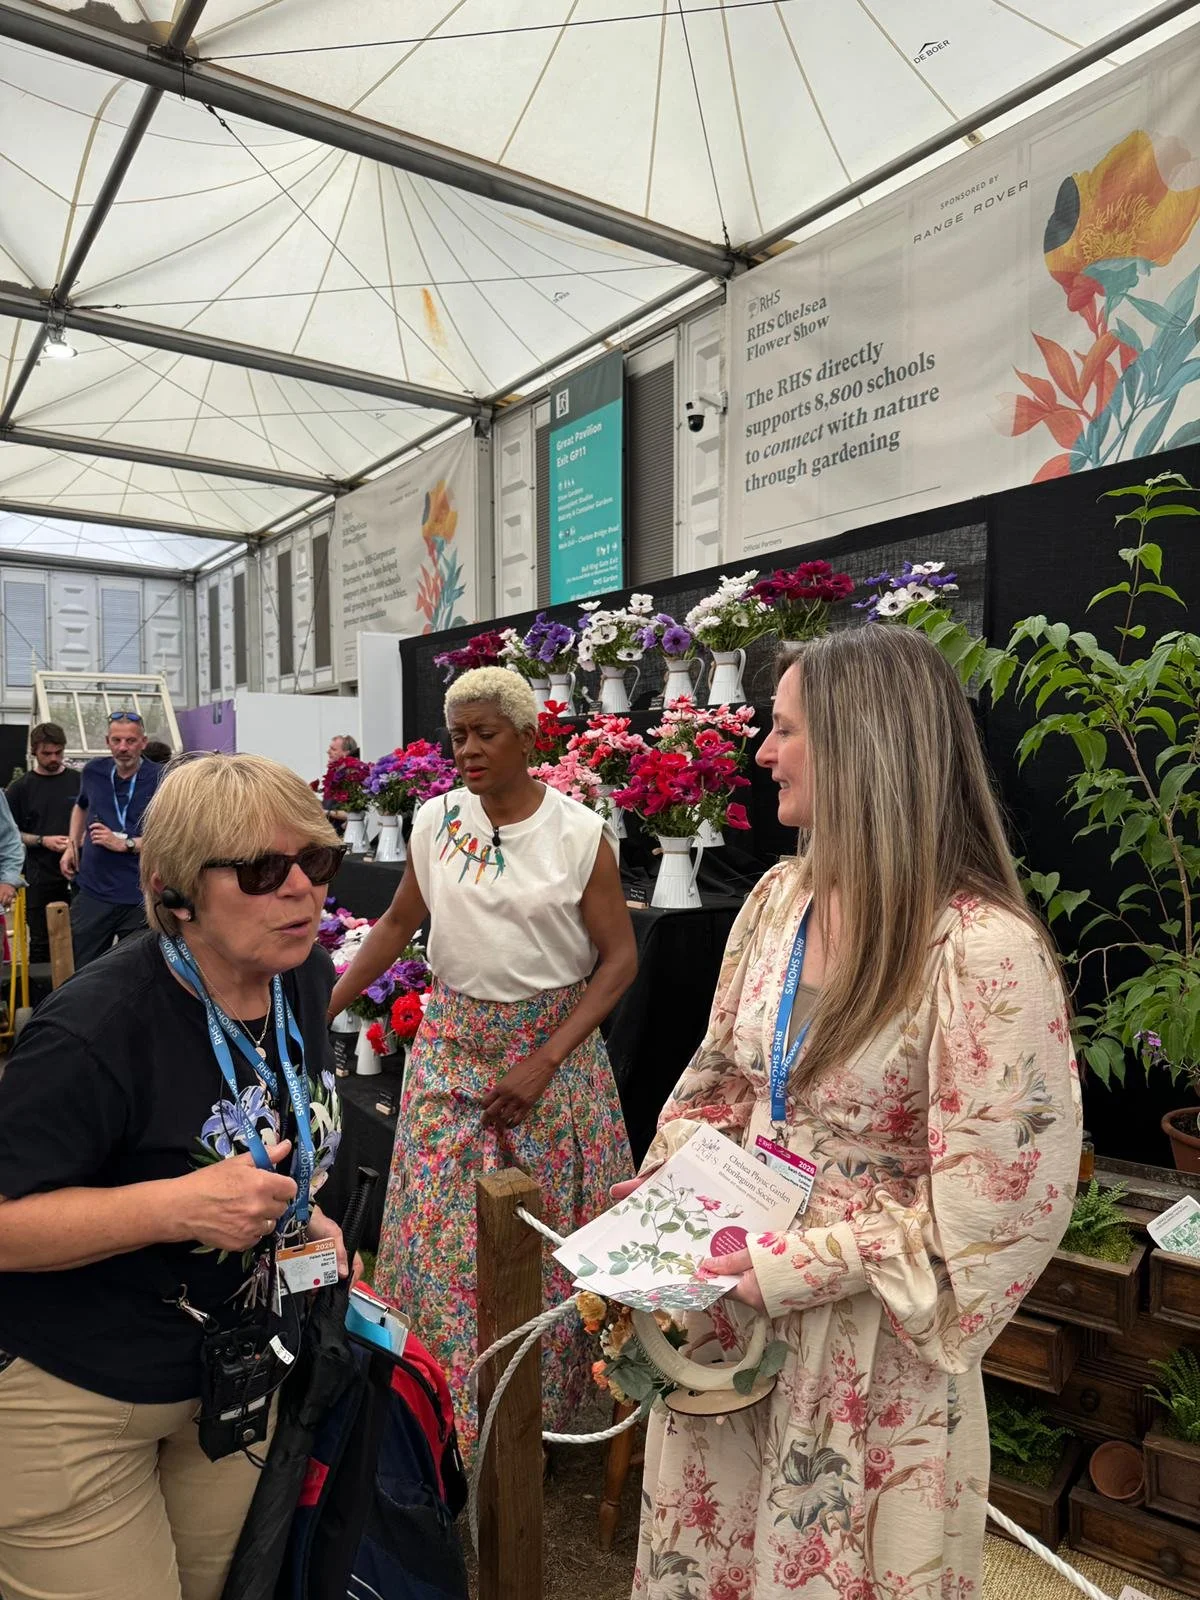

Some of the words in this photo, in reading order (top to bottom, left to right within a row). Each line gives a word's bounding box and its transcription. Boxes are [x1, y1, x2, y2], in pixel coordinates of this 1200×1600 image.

[913, 52, 927, 65] DE
[925, 39, 950, 58] BOER
[940, 181, 987, 210] SPONSORED
[988, 173, 1000, 186] BY
[913, 212, 965, 245] RANGE
[973, 179, 1029, 214] ROVER
[760, 289, 781, 312] RHS
[746, 318, 775, 343] RHS
[777, 297, 827, 329] Chelsea
[746, 334, 792, 362] Flower
[793, 315, 830, 342] Show
[745, 388, 774, 410] The
[777, 368, 813, 398] RHS
[815, 341, 884, 382] directly
[745, 400, 811, 438] supports
[814, 381, 863, 412] 8,800
[867, 352, 935, 393] schools
[556, 435, 574, 451] Great
[575, 423, 602, 442] Pavilion
[745, 450, 760, 465] to
[763, 424, 824, 459] connect
[827, 407, 868, 436] with
[873, 387, 940, 421] nature
[556, 454, 569, 468] Exit
[569, 446, 586, 461] GP11
[745, 458, 808, 493] through
[811, 431, 900, 477] gardening
[794, 938, 805, 956] RHS
[784, 956, 801, 995] SHOWS
[275, 993, 284, 1029] SHOWS
[211, 1025, 223, 1046] RHS
[774, 1030, 784, 1051] RHS
[257, 1061, 271, 1080] RHS
[771, 1051, 781, 1087] SHO
[780, 1041, 800, 1079] SHOWS
[282, 1061, 295, 1079] RHS
[289, 1080, 305, 1117] SHOWS
[775, 1078, 786, 1100] RHS
[243, 1118, 256, 1140] RHS
[722, 1162, 756, 1192] Florilegium
[755, 1187, 778, 1208] Society
[729, 1154, 751, 1175] Chelsea
[751, 1169, 769, 1188] Physic
[769, 1184, 791, 1203] Garden
[798, 1160, 815, 1175] 2026
